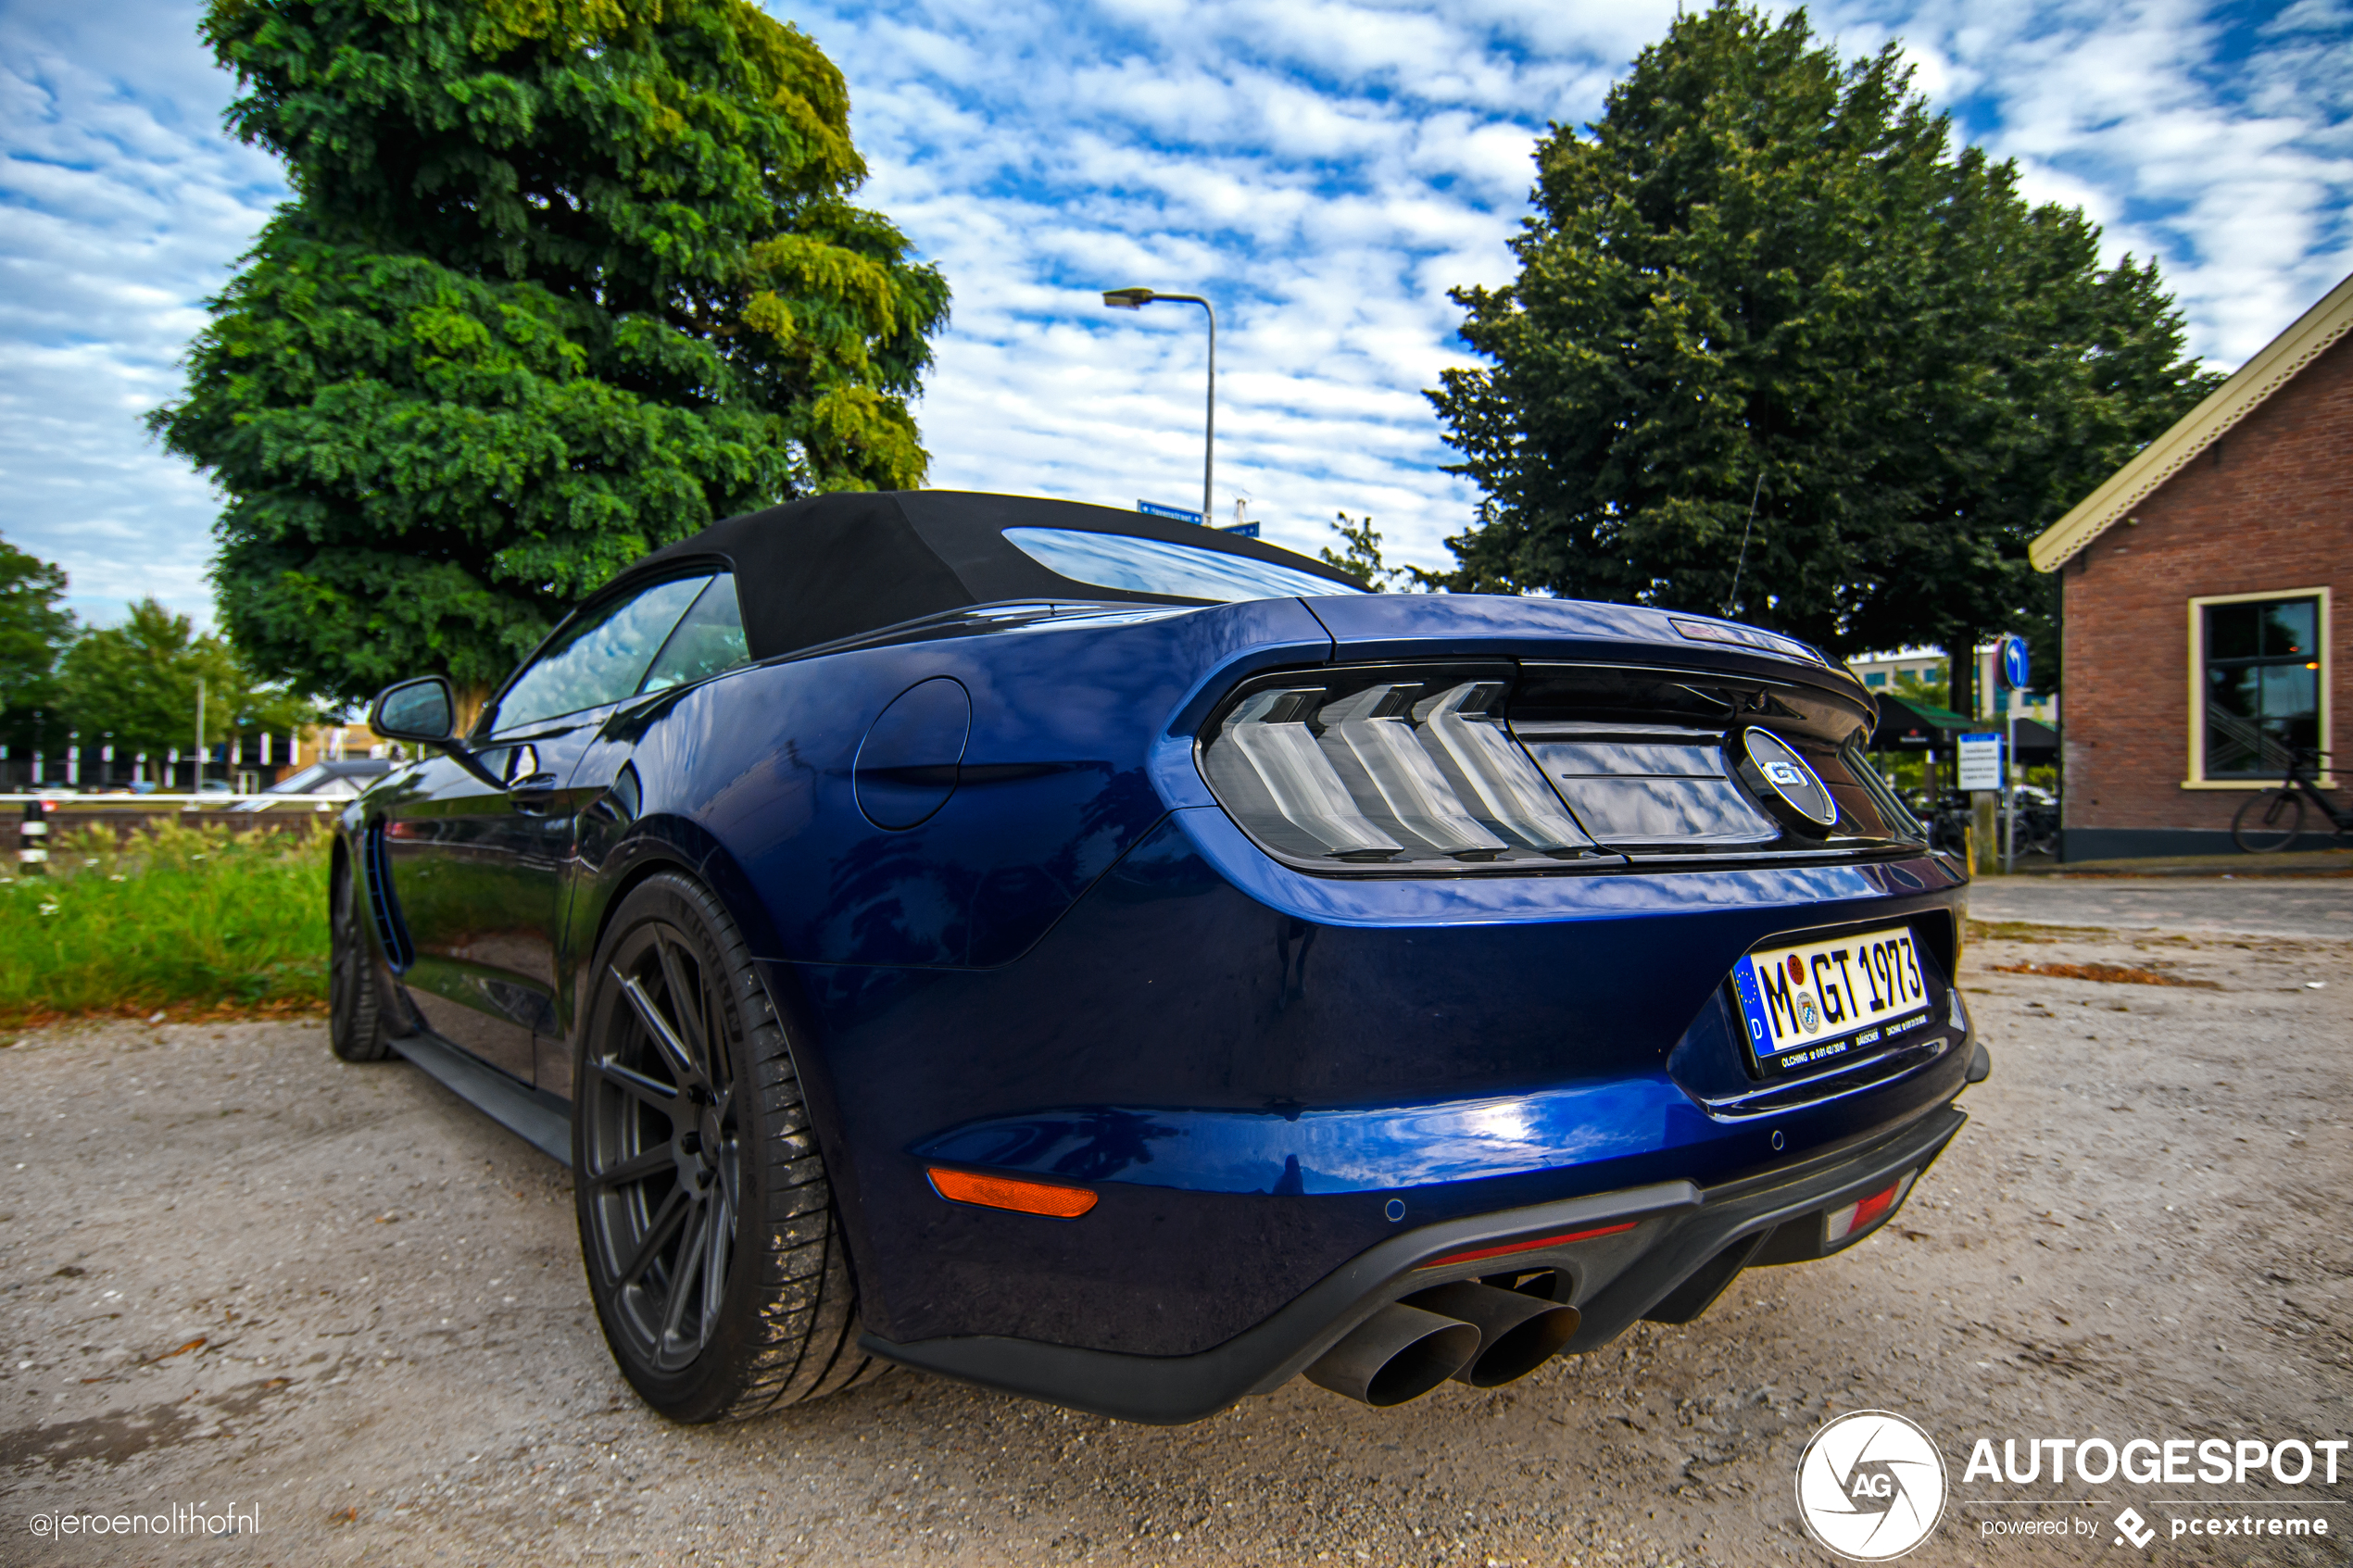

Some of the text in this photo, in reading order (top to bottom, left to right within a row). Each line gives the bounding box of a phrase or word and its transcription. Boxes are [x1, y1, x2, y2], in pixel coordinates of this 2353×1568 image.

[1763, 761, 1808, 786] GT
[684, 906, 740, 1033] MICHELIN
[1759, 962, 1799, 1038] M
[1810, 949, 1857, 1023] GT
[1858, 937, 1921, 1012] 1973
[1751, 1018, 1762, 1039] D
[1781, 1052, 1808, 1068] OLCHING
